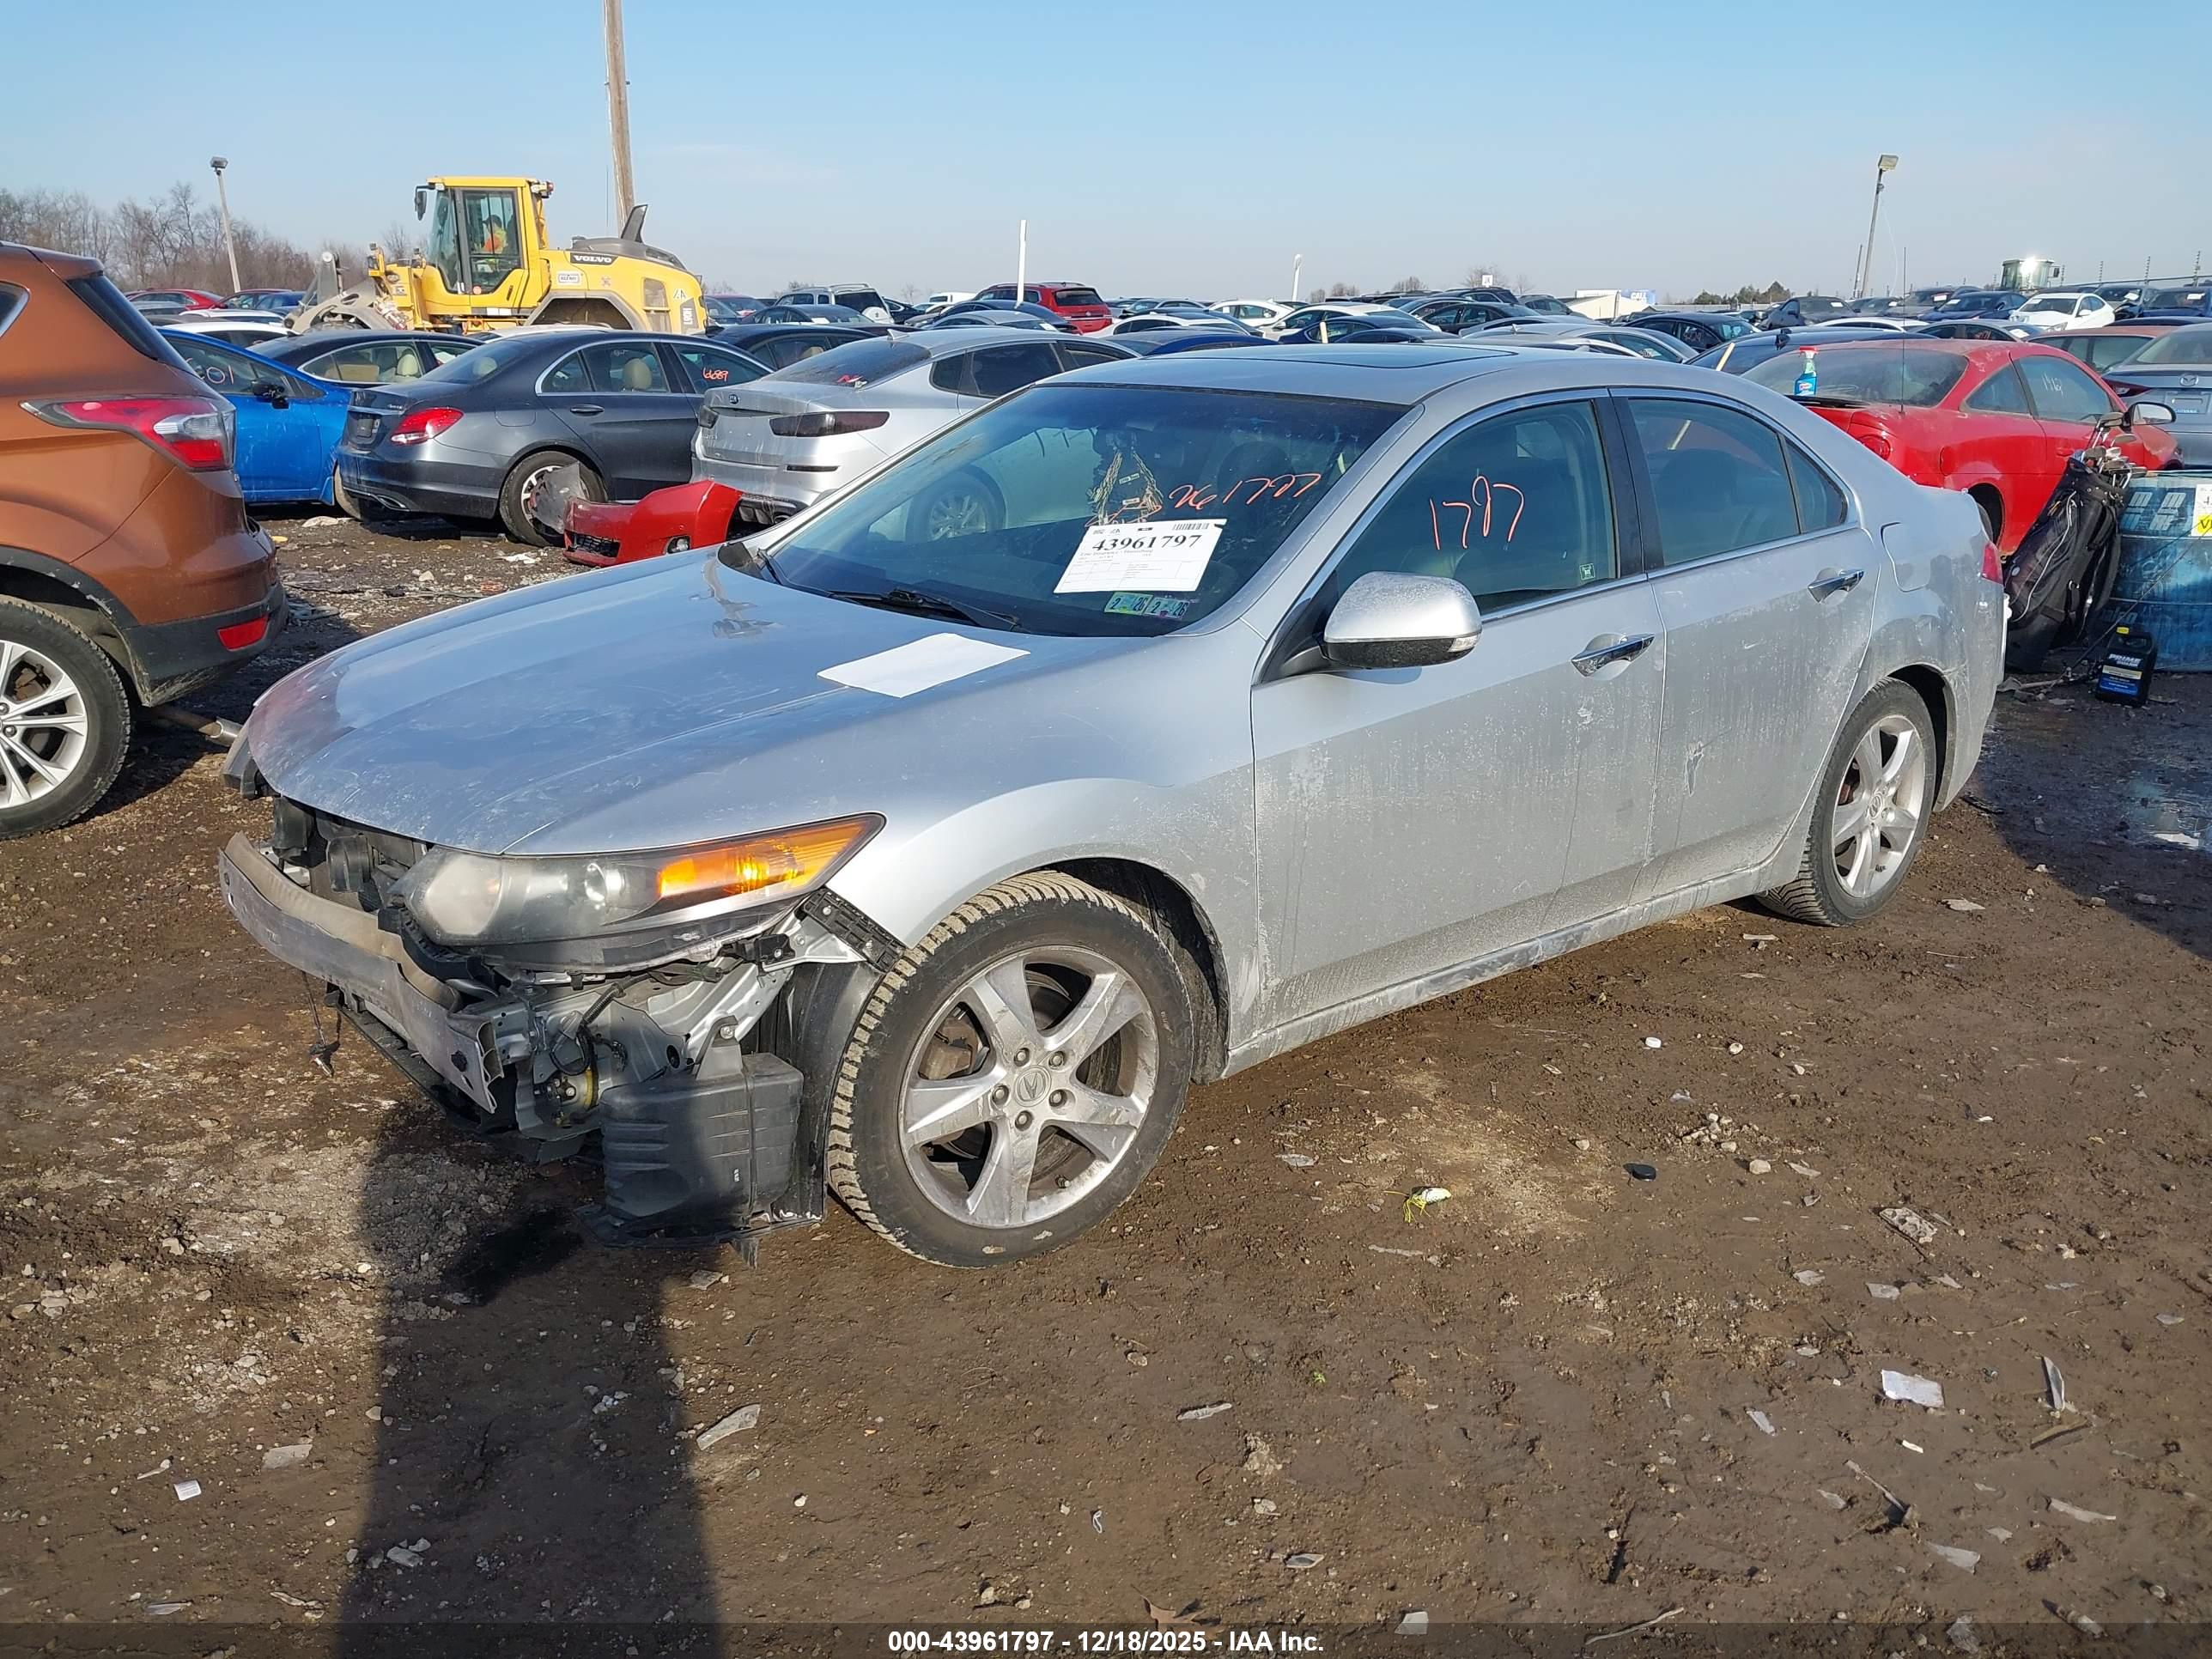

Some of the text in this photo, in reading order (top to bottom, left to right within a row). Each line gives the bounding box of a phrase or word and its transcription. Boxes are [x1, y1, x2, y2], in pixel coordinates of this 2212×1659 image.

[573, 255, 612, 264] VOLVO
[1429, 475, 1525, 550] 1797
[1091, 534, 1203, 551] 43961797
[2108, 653, 2143, 664] PRIME
